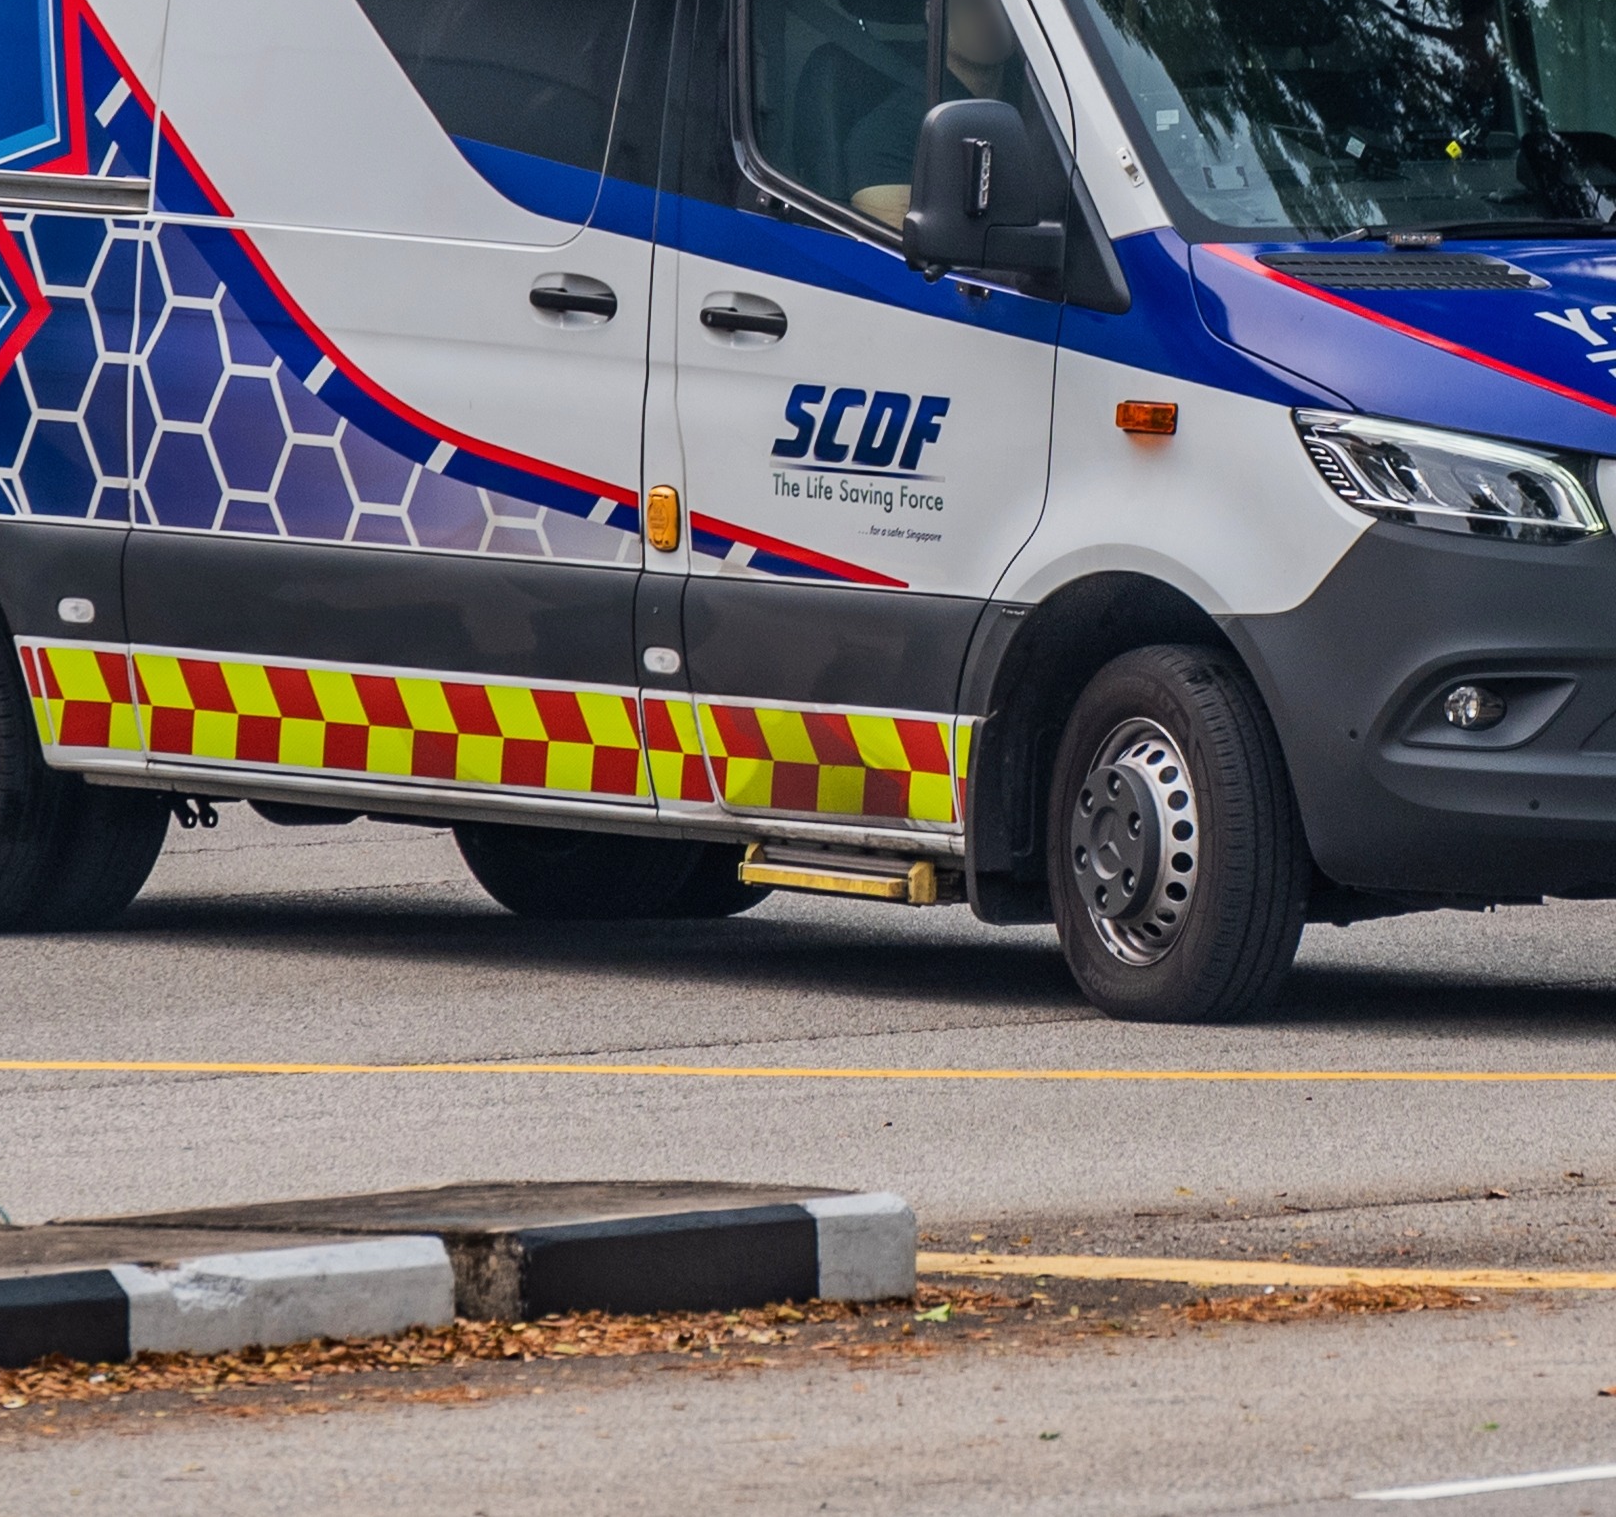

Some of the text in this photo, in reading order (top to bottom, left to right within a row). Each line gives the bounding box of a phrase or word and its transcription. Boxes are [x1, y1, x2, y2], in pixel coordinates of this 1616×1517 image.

[771, 383, 951, 470] SCDF
[772, 472, 944, 514] The Life Saving Force
